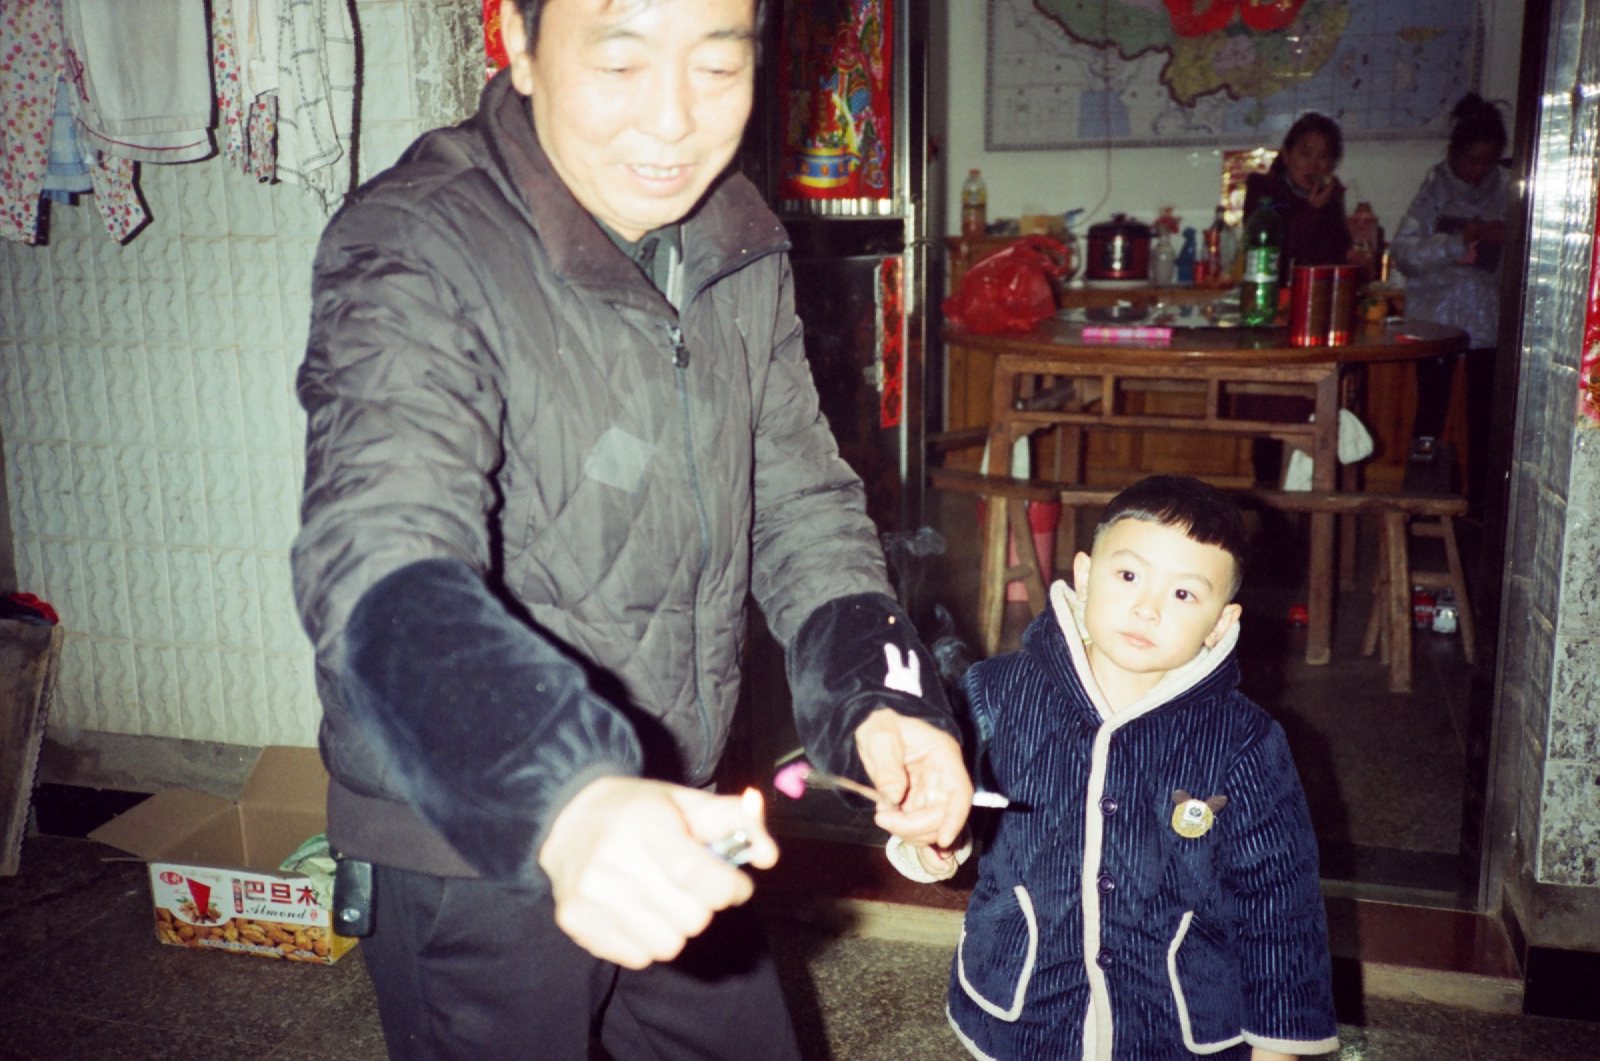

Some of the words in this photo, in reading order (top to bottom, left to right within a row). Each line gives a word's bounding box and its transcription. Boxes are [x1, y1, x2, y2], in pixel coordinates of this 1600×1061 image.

[244, 880, 319, 906] 巴旦木
[246, 903, 307, 919] Almond
